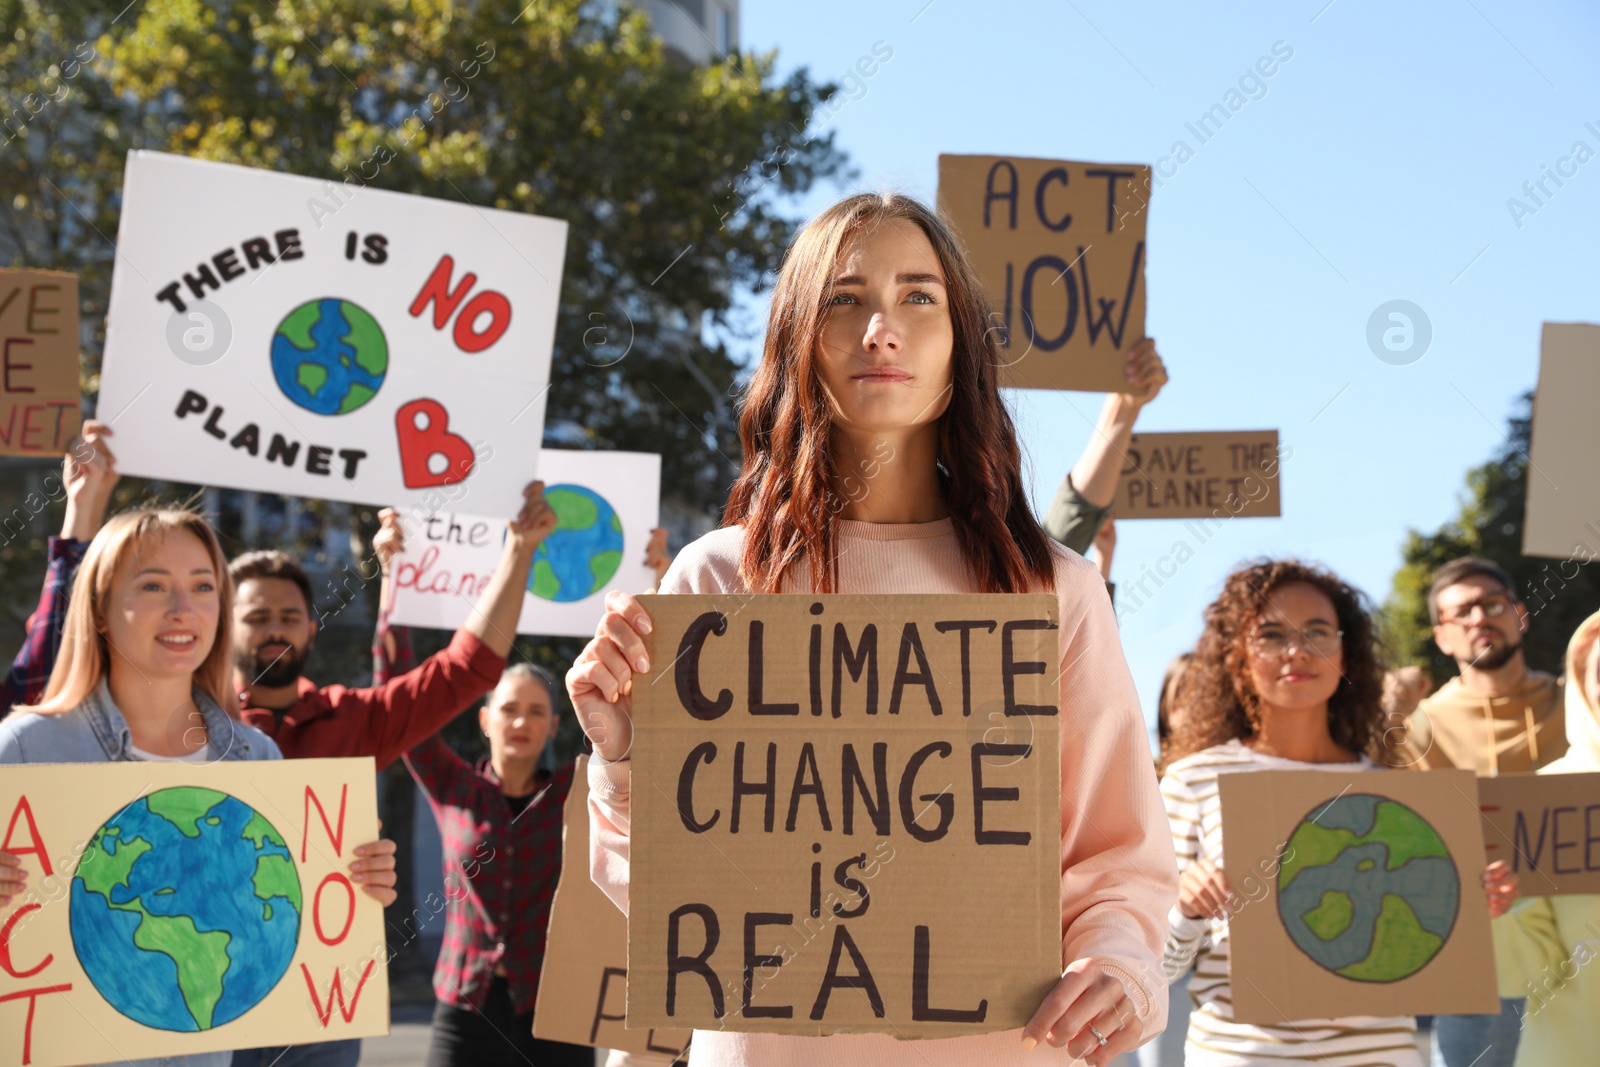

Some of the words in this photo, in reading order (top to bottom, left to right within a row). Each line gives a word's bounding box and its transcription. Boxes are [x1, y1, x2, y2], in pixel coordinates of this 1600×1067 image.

[983, 160, 1136, 233] ACT
[156, 228, 304, 314] THERE
[345, 231, 389, 265] IS
[408, 254, 513, 354] NO
[174, 389, 367, 481] PLANET
[395, 397, 476, 490] B
[1227, 441, 1273, 472] THE
[424, 512, 490, 547] the
[1126, 477, 1245, 509] PLANET
[387, 545, 496, 616] plane
[677, 741, 1033, 845] CHANGE
[666, 903, 989, 1022] REAL
